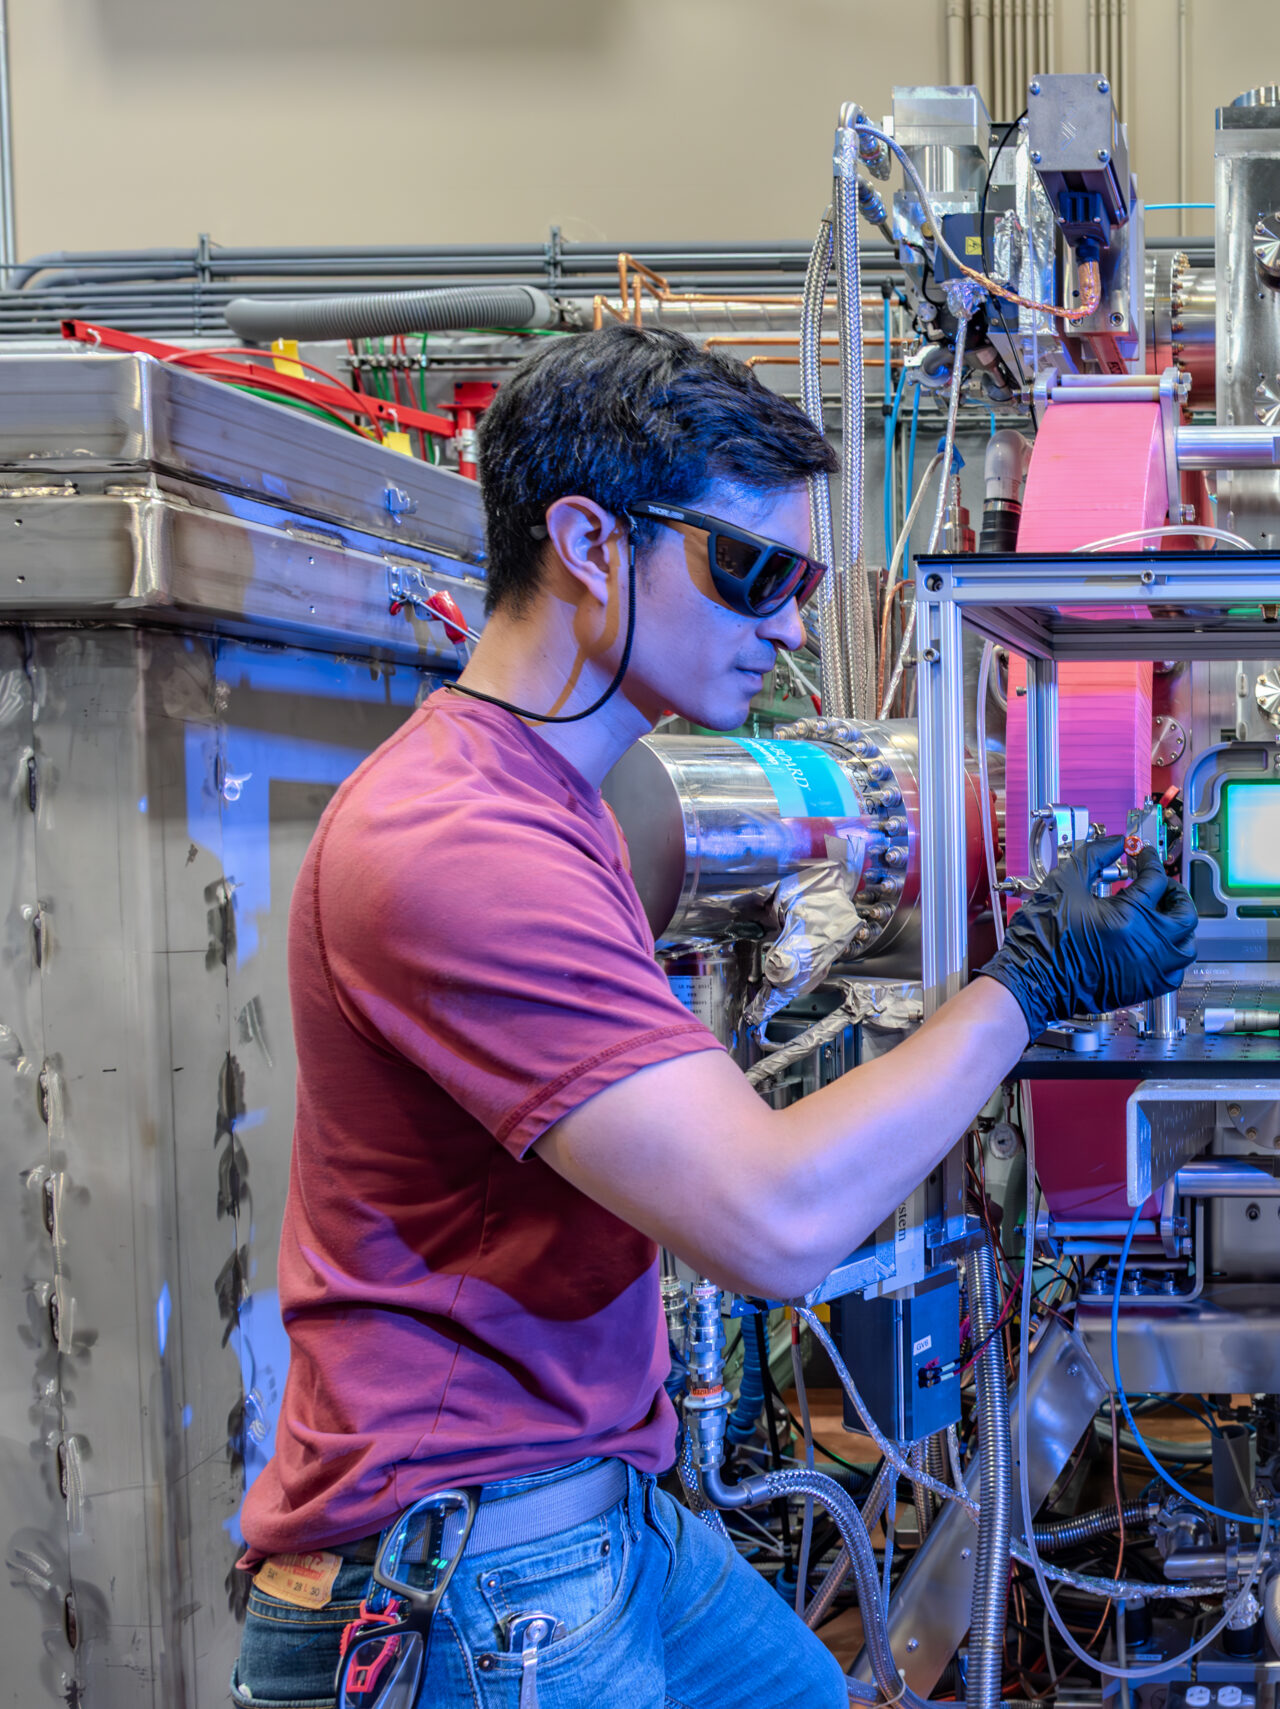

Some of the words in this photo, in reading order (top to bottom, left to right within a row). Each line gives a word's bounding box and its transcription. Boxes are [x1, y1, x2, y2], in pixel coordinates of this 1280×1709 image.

[898, 1203, 907, 1241] stem
[294, 1582, 302, 1591] 28
[310, 1587, 320, 1596] 30
